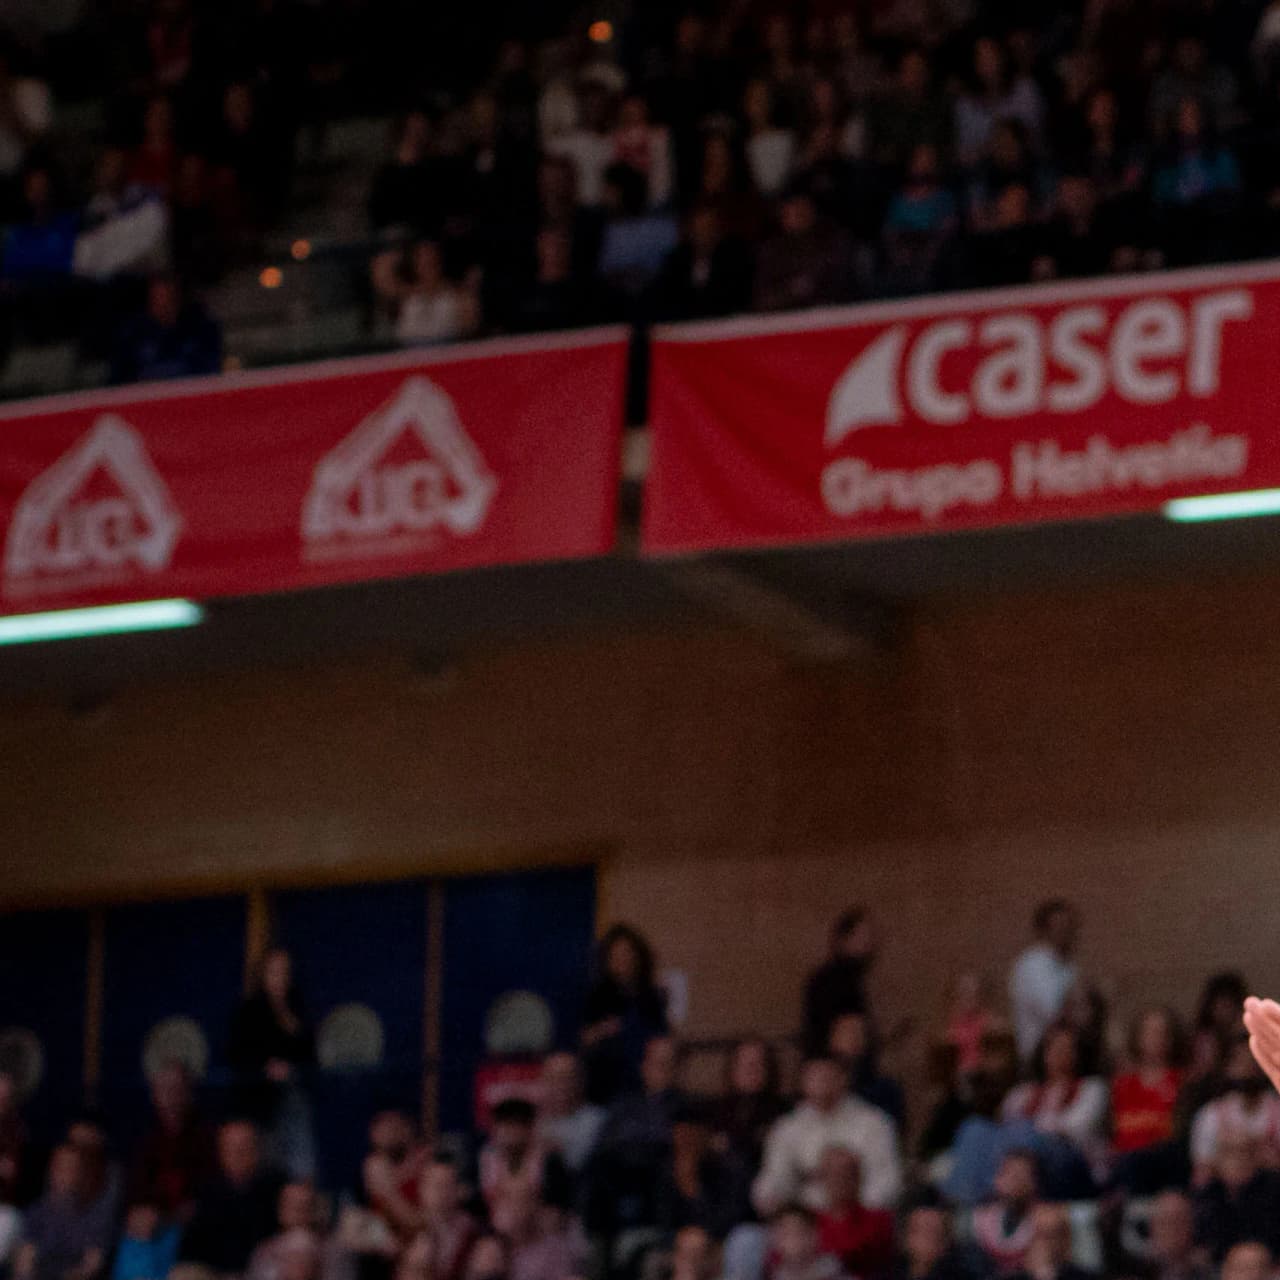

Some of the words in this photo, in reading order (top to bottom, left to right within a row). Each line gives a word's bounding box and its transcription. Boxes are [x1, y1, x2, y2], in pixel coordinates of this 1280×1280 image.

[906, 288, 1254, 425] caser
[819, 457, 1001, 519] Grupo
[1010, 424, 1248, 498] Helvetia
